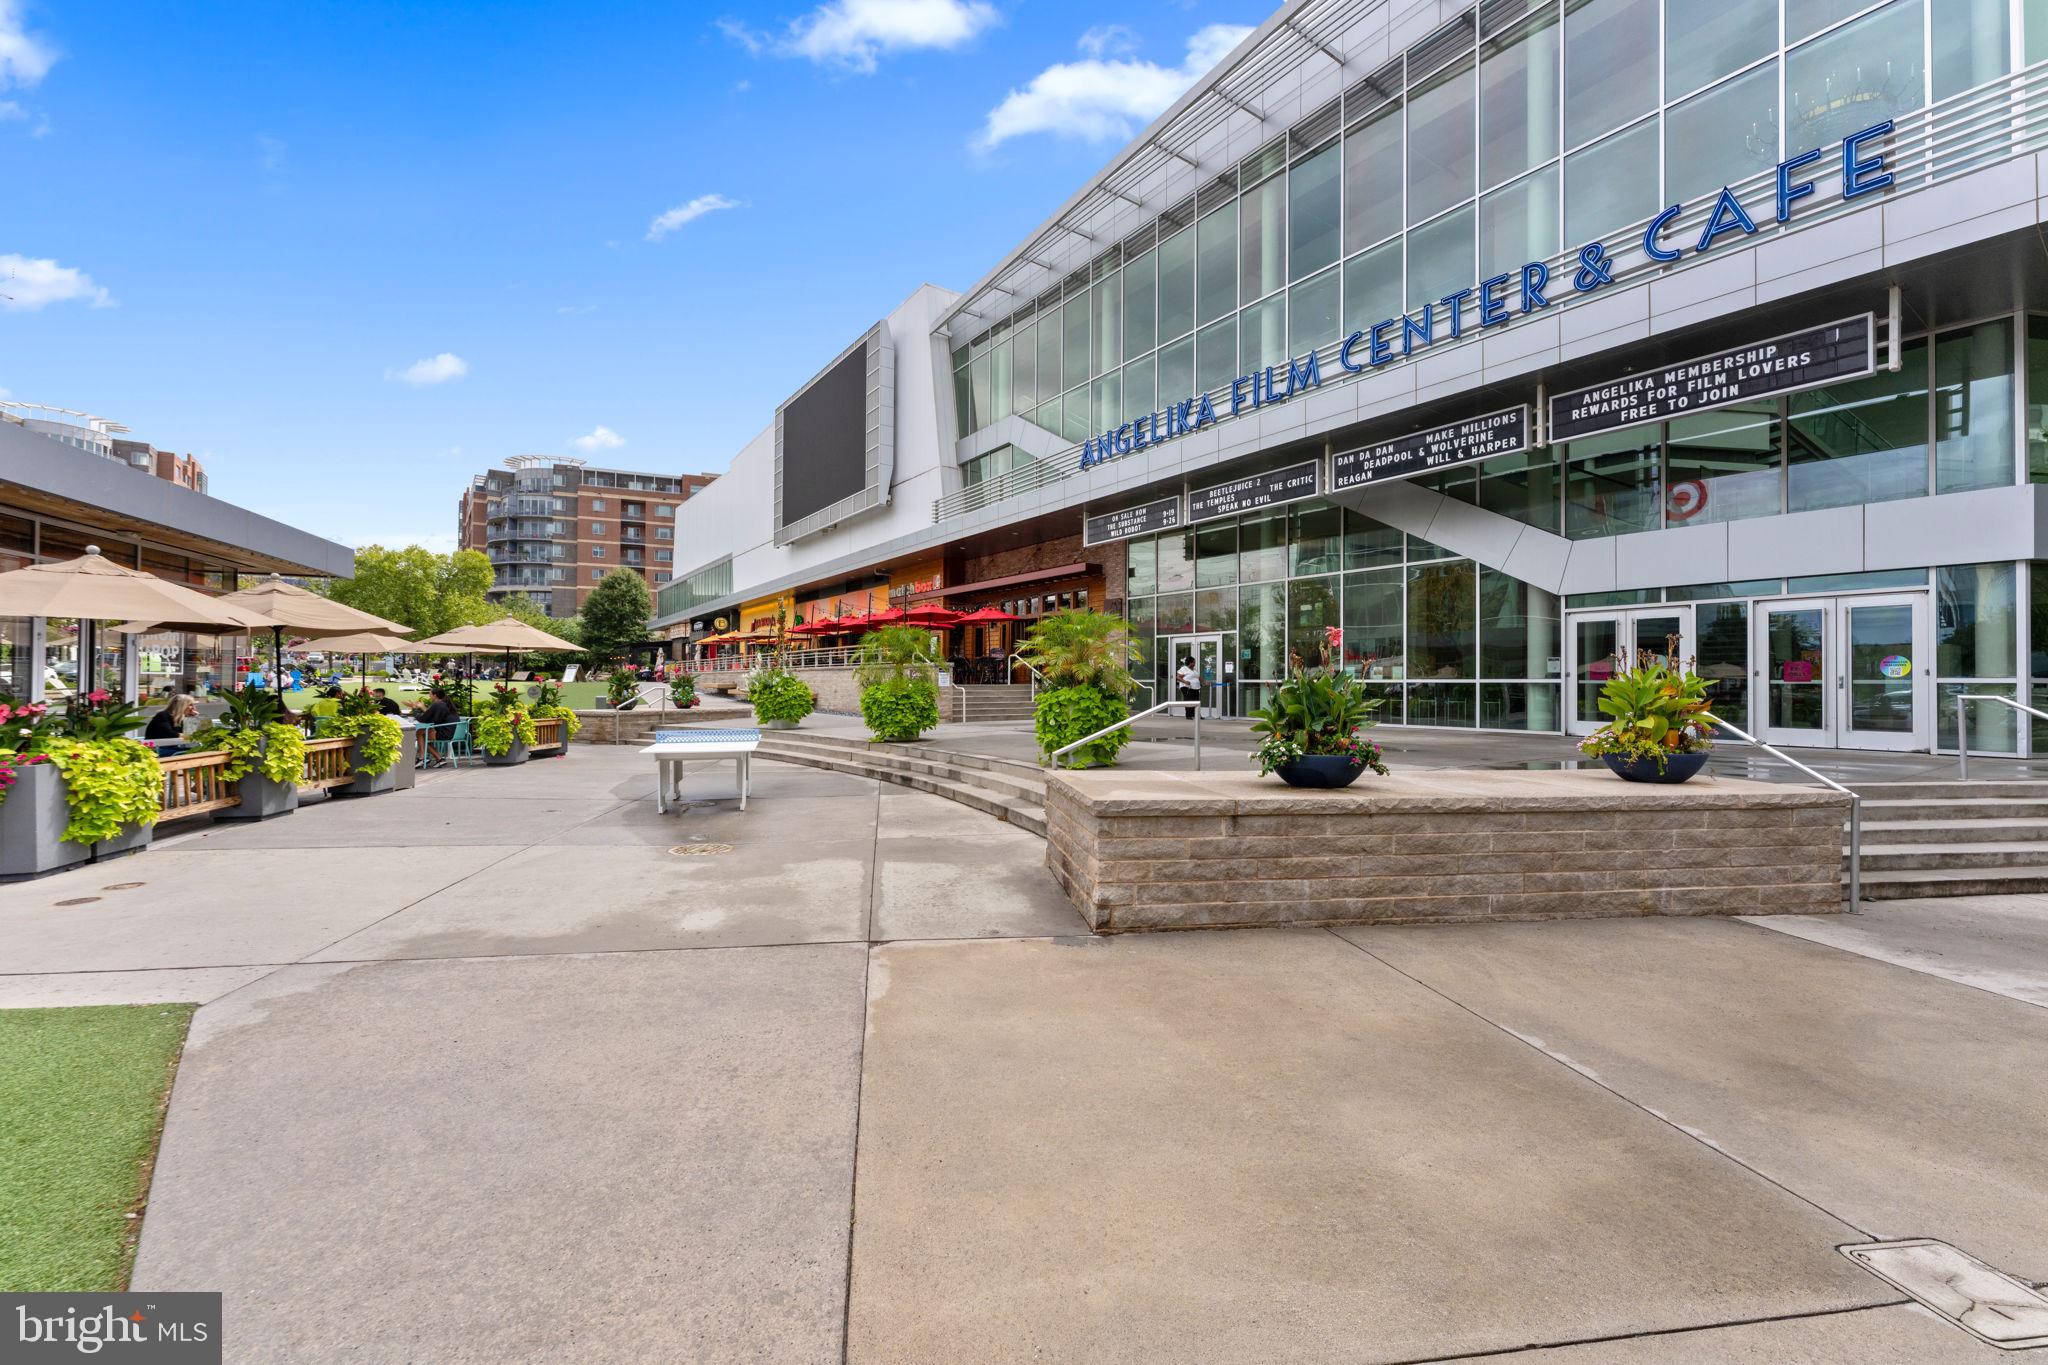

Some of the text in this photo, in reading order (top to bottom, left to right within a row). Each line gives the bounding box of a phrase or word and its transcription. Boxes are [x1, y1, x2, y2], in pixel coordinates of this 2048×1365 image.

[1079, 119, 1895, 470] ANGELIKA FILM CENTER & CAFE
[1583, 345, 1778, 405] ANGELIKA MEMBERSHIP
[1572, 352, 1811, 420] REWARDS FOR FILM LOVERS
[1620, 384, 1739, 421] FREE TO JOIN
[1426, 412, 1517, 444] MAKE MILLIONS
[1337, 444, 1394, 466] DAN DA DAN
[1363, 430, 1494, 470] DEADPOOL & WOLVERINE
[1426, 437, 1517, 466] WILL & HARPER
[1209, 478, 1261, 498] BEETLEJUICE 2
[1269, 474, 1313, 492] THE CRITIC
[1338, 470, 1373, 486] REAGAN
[1192, 494, 1235, 511] THE TEMPLES
[1217, 494, 1271, 513] SPEAK NO EVIL
[1107, 523, 1116, 531] THE
[1118, 516, 1147, 528] SUBSTANCE
[1120, 511, 1133, 519] SALE
[1135, 508, 1147, 516] NOW
[1110, 528, 1122, 537] WILD
[1124, 525, 1142, 534] ROBOT
